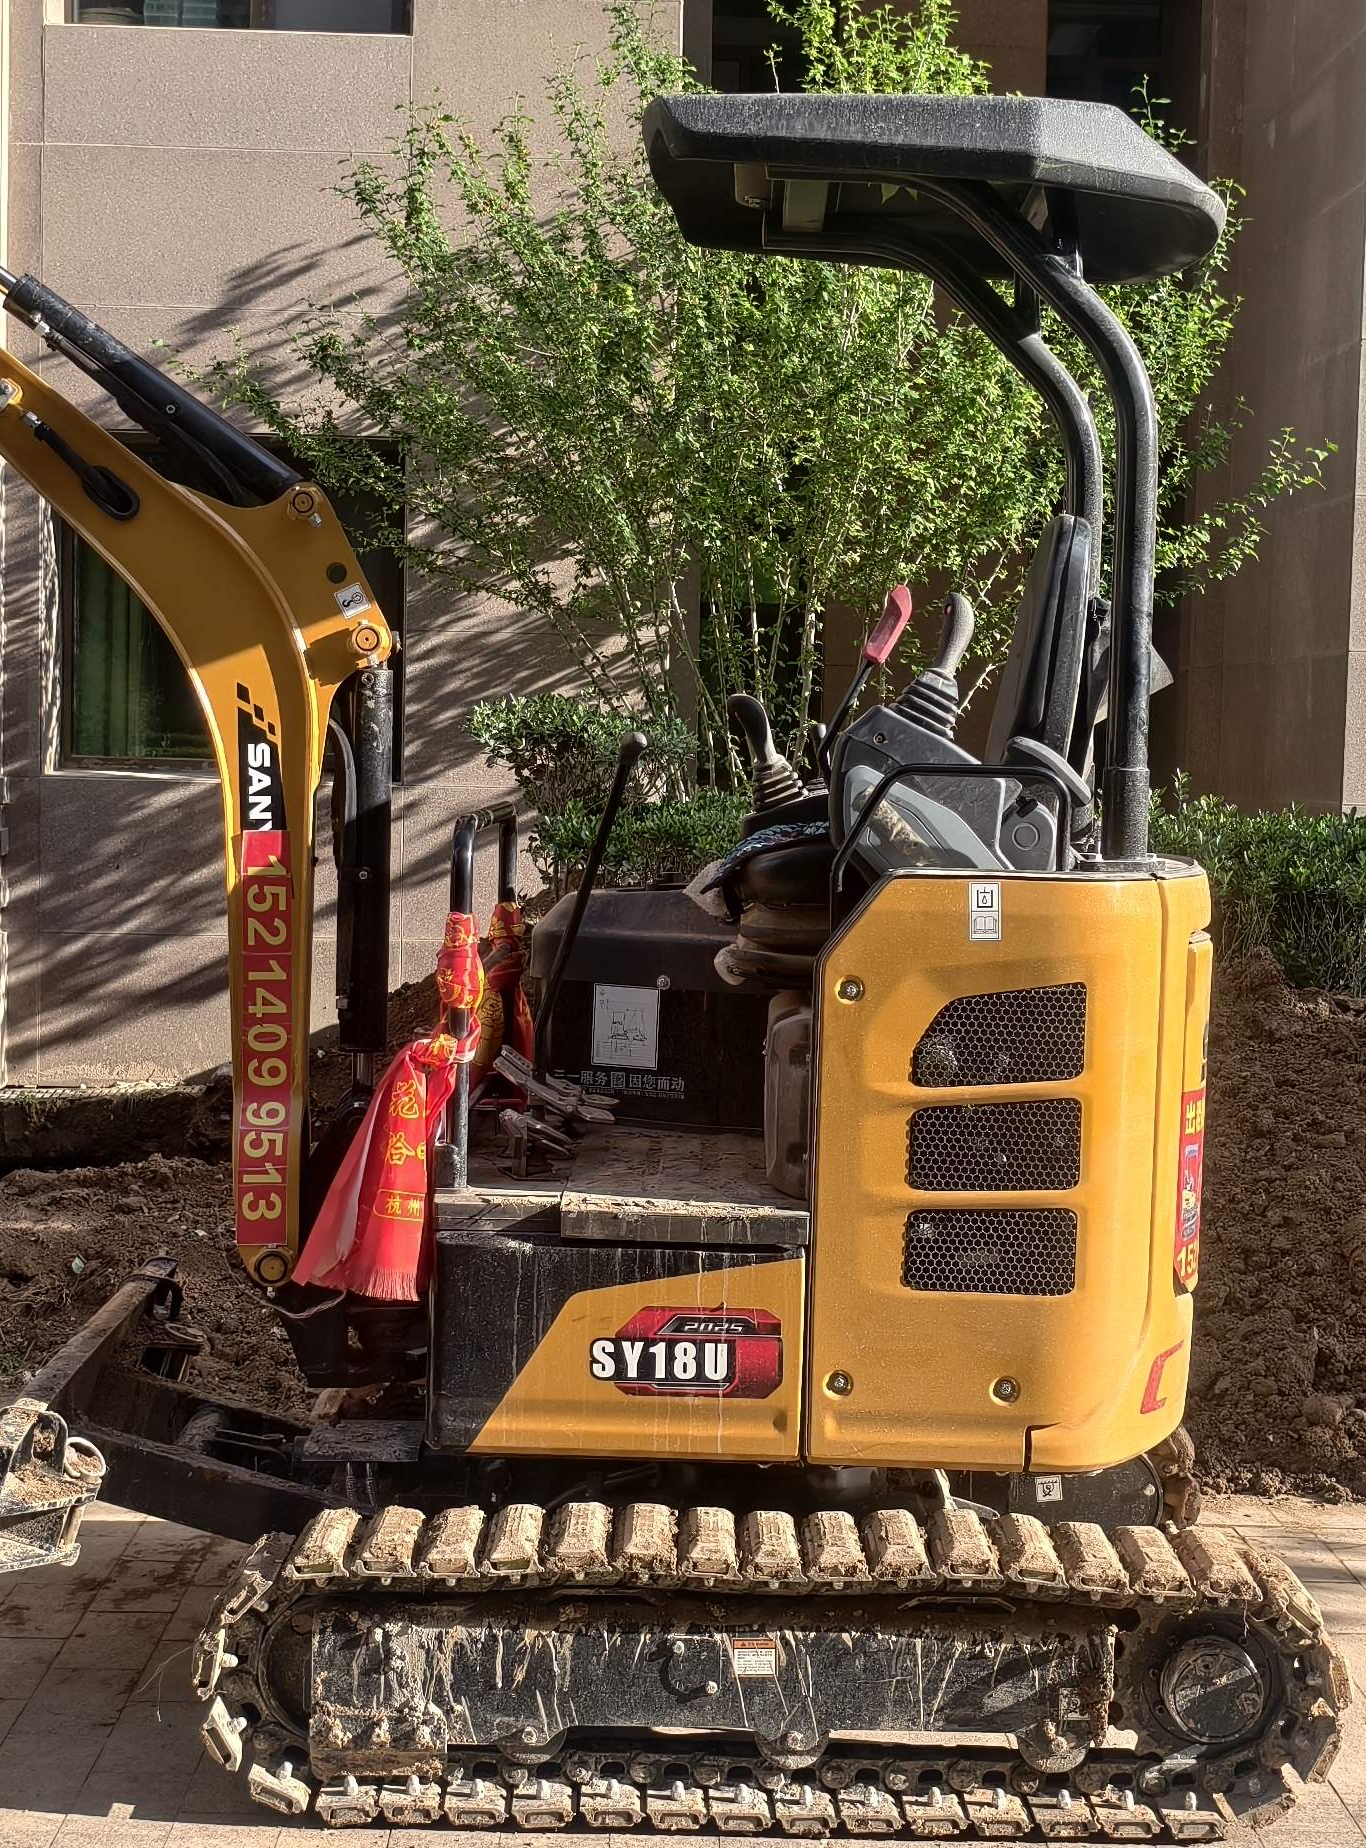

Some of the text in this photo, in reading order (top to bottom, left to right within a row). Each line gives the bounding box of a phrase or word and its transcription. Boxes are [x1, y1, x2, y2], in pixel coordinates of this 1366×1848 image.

[247, 742, 273, 832] SAN
[629, 1074, 685, 1092] 因您而动
[241, 1101, 286, 1221] 9513
[684, 1321, 745, 1334] 2025
[592, 1339, 729, 1382] SY18U
